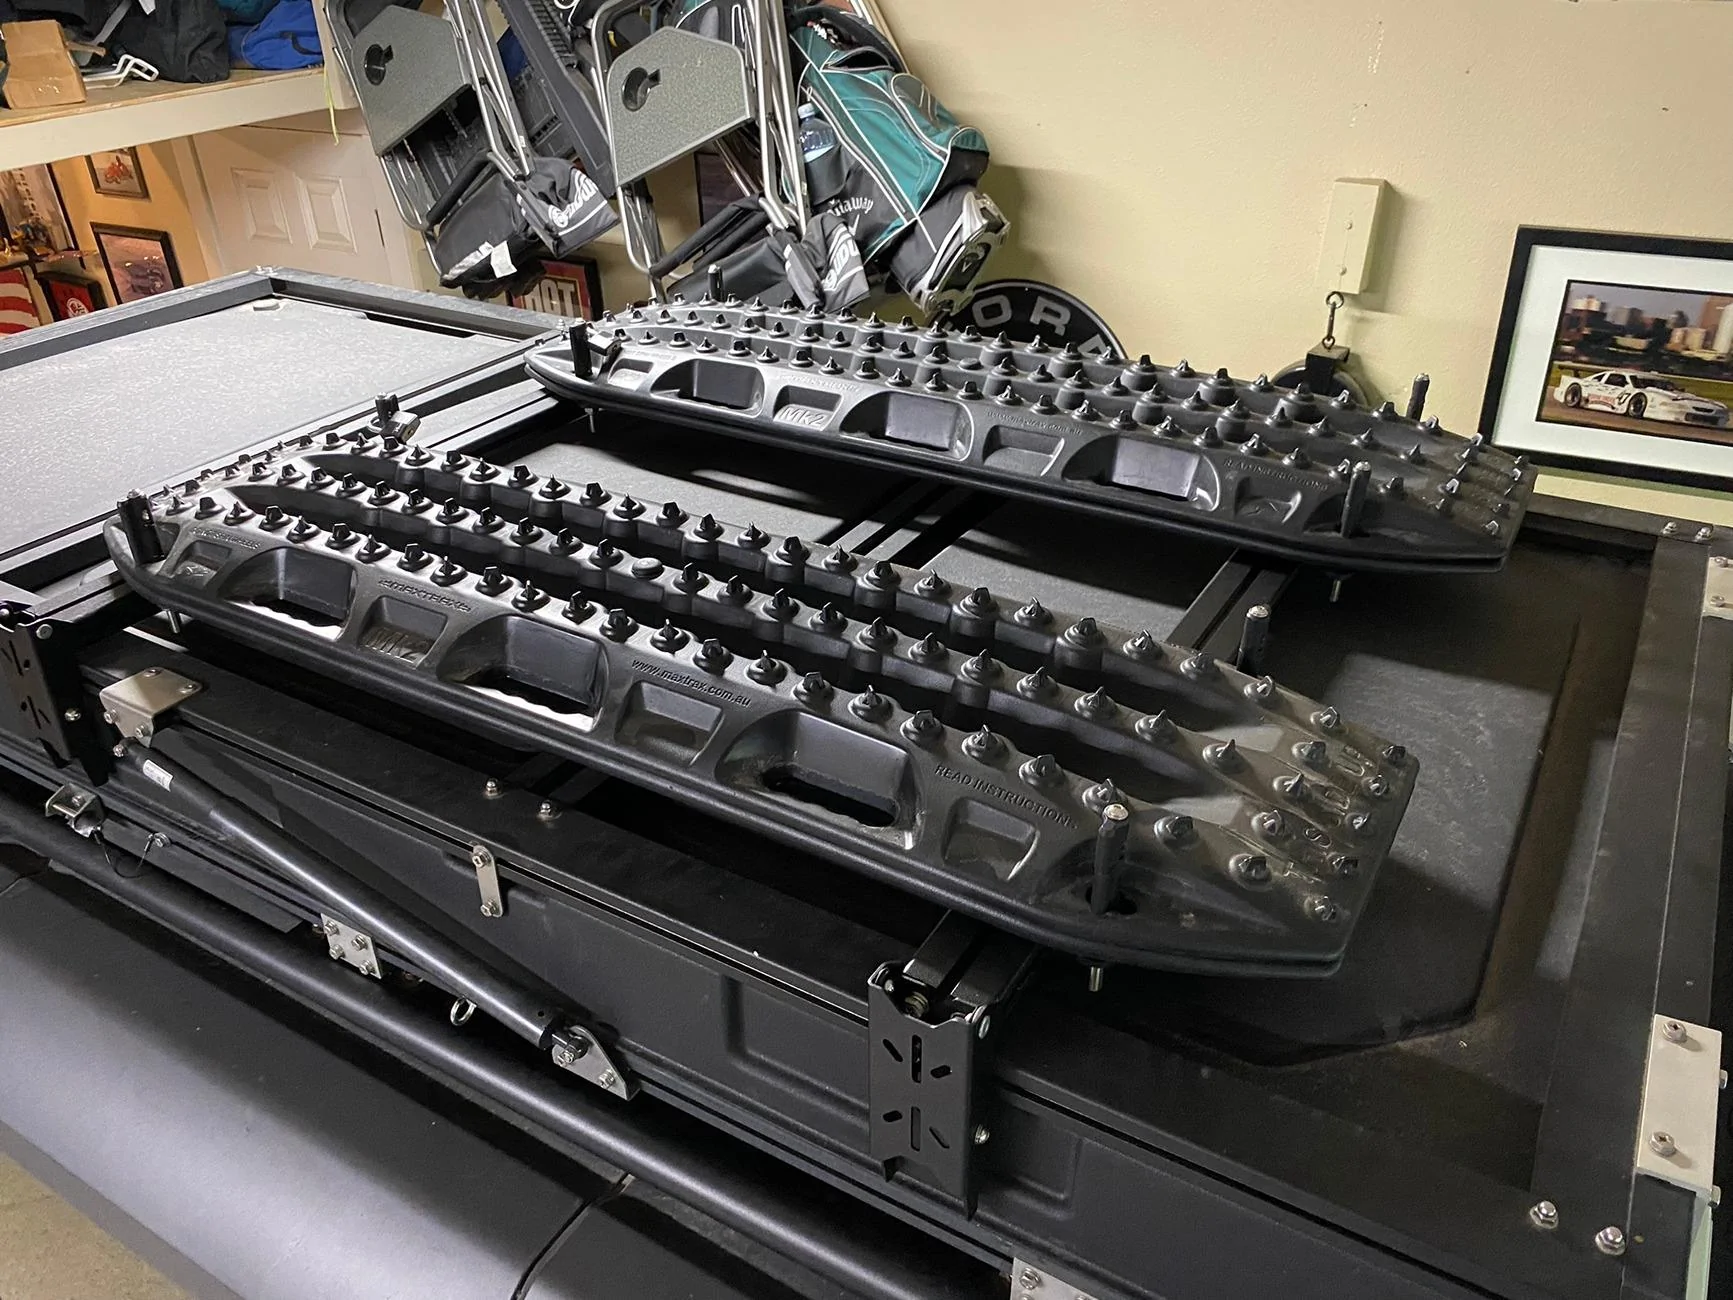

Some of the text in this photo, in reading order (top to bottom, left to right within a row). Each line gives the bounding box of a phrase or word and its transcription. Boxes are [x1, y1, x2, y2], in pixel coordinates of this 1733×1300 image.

[781, 407, 827, 427] Mk2
[631, 659, 752, 707] www.maxtrax.com.au
[934, 764, 973, 786] READ
